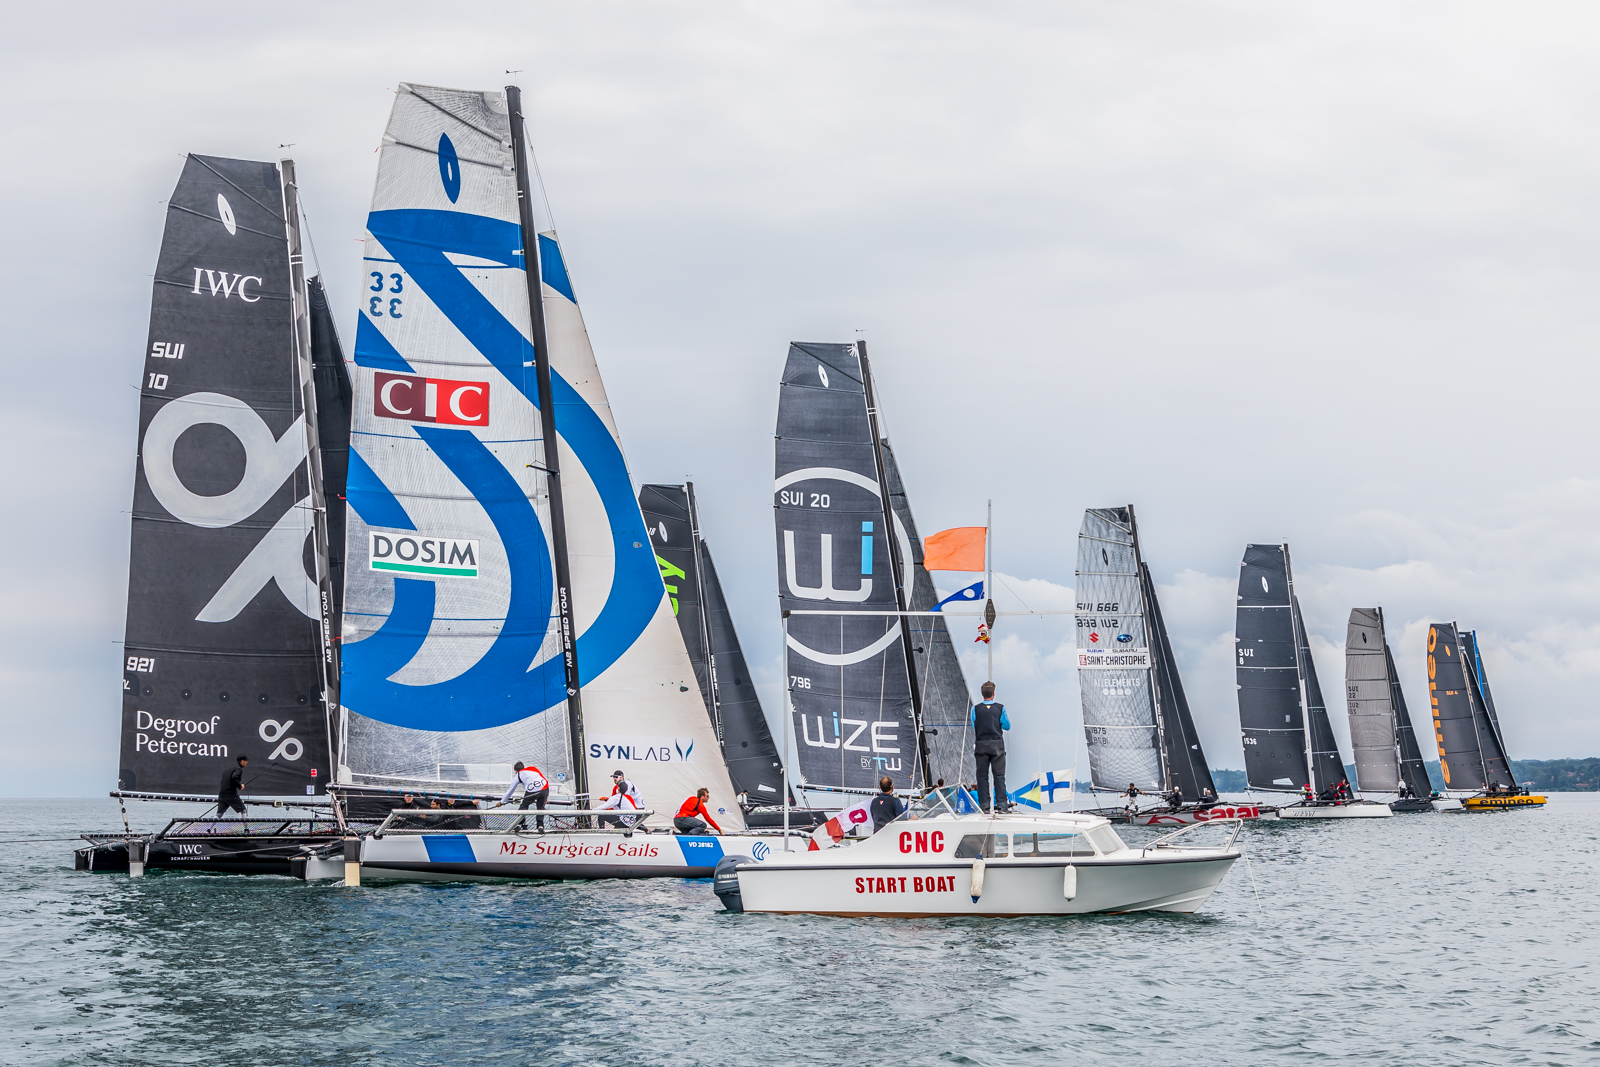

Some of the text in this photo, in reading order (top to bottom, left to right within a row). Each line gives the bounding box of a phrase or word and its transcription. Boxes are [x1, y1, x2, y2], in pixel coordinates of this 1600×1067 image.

[191, 267, 262, 303] IWC
[370, 271, 404, 293] 33
[151, 342, 185, 359] SUI
[148, 373, 169, 390] 10
[380, 379, 483, 421] CIC
[780, 491, 830, 508] SUI 20
[373, 535, 477, 566] DOSIM
[560, 587, 568, 615] TOUR
[1096, 603, 1119, 612] 666
[323, 618, 331, 647] SPEED
[562, 617, 571, 649] SPEED
[1086, 655, 1147, 666] SAINT-CHRISTOPHE
[1238, 648, 1254, 656] SUI
[1239, 657, 1244, 665] 8
[126, 656, 155, 673] 921
[790, 675, 811, 689] 796
[136, 710, 221, 738] Degroof
[136, 733, 228, 757] Petercam
[589, 743, 670, 762] SYNLAB
[860, 758, 872, 768] BY
[178, 844, 203, 855] IWC
[499, 841, 659, 858] M2 Surgical Sails
[898, 830, 945, 854] CNC
[855, 875, 956, 894] START BOAT
